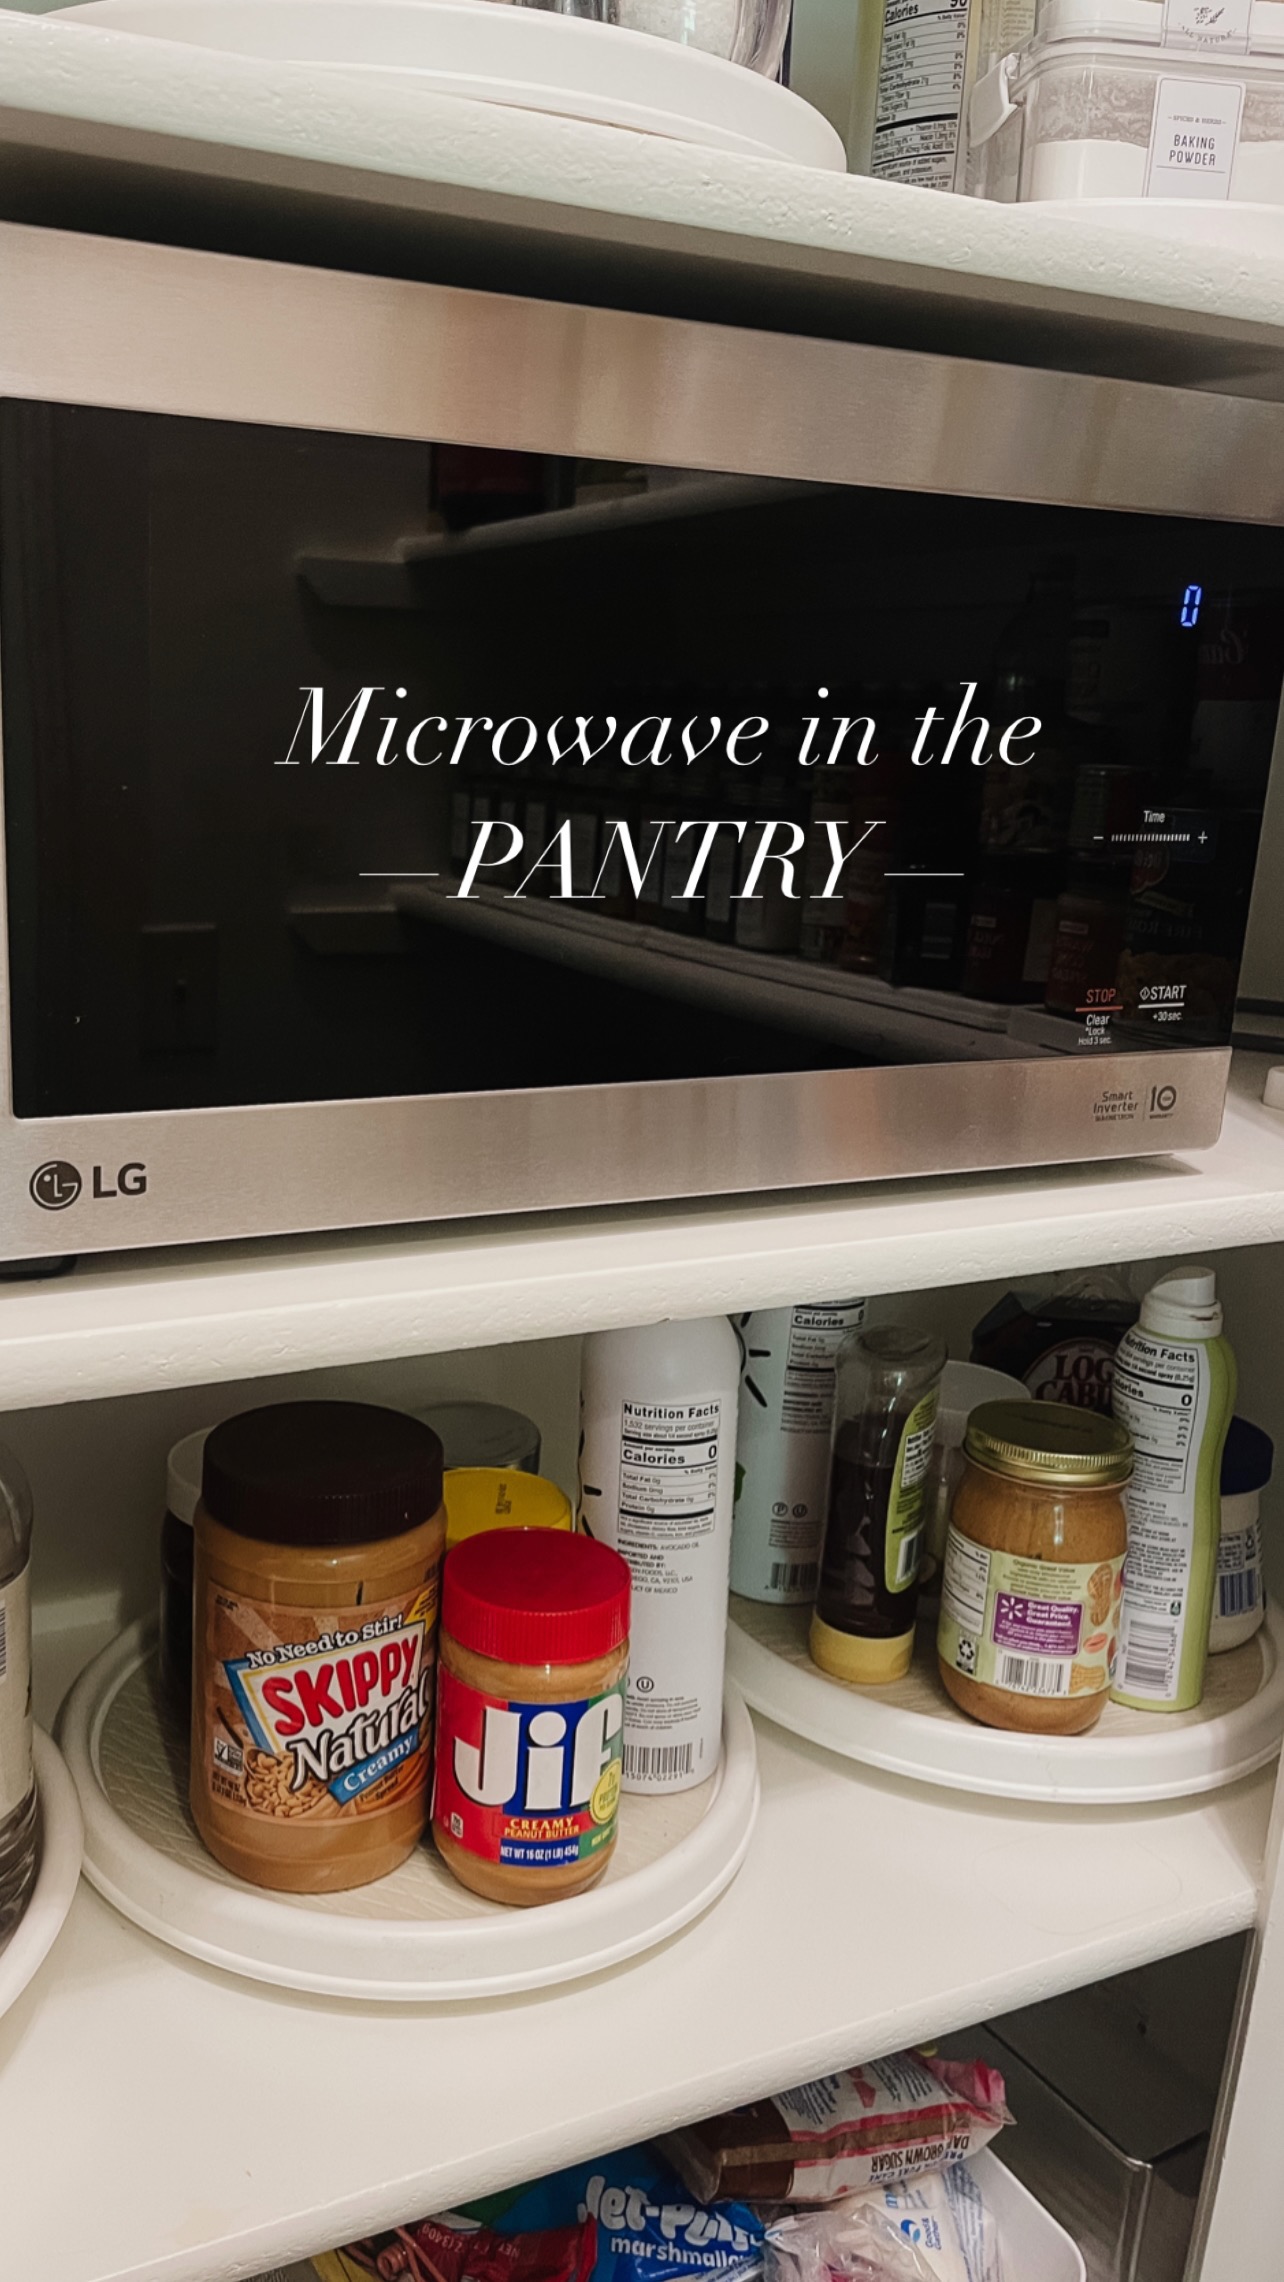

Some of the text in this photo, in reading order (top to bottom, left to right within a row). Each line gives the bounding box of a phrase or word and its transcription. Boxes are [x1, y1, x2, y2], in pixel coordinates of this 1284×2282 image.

[885, 4, 919, 22] Calories
[1174, 134, 1215, 150] BAKING
[1168, 150, 1216, 166] POWDER
[1144, 810, 1165, 823] Time
[1087, 988, 1117, 1003] STOP
[1150, 985, 1187, 1000] START
[1086, 1014, 1110, 1026] Clear
[1102, 1091, 1133, 1102] Smart
[1150, 1085, 1177, 1112] 10
[1093, 1102, 1138, 1113] Inverter
[93, 1162, 147, 1199] LG
[794, 1315, 844, 1326] Calories
[1161, 1348, 1195, 1362] Facts
[1053, 1352, 1114, 1382] LOG
[1181, 1393, 1192, 1407] 0
[624, 1403, 719, 1419] Nutrition Facts
[645, 1423, 673, 1433] servings
[675, 1423, 685, 1432] per
[687, 1421, 714, 1430] container
[623, 1445, 717, 1464] Calories 0
[622, 1482, 647, 1492] Sodium
[621, 1501, 645, 1510] Protein
[622, 1492, 638, 1501] Total
[639, 1495, 685, 1505] Carbohydrate
[1027, 1609, 1049, 1618] Great
[1028, 1601, 1049, 1611] Great
[247, 1614, 404, 1669] No Need to Stir!
[261, 1634, 419, 1737] SKIPPY
[287, 1667, 430, 1791] Natural
[454, 1693, 623, 1811] Jif
[343, 1735, 413, 1791] Creamy
[510, 1816, 573, 1830] CREAMY
[504, 1827, 542, 1839] PEANUT
[546, 1824, 580, 1838] BUTTER
[500, 1845, 513, 1857] NET
[514, 1848, 525, 1859] WT
[526, 1849, 534, 1860] 16
[535, 1848, 544, 1860] OZ
[871, 2151, 903, 2173] SUGAR
[905, 2144, 944, 2165] BROWN
[868, 2165, 922, 2183] PURE CANE
[611, 2237, 748, 2268] marshmallo
